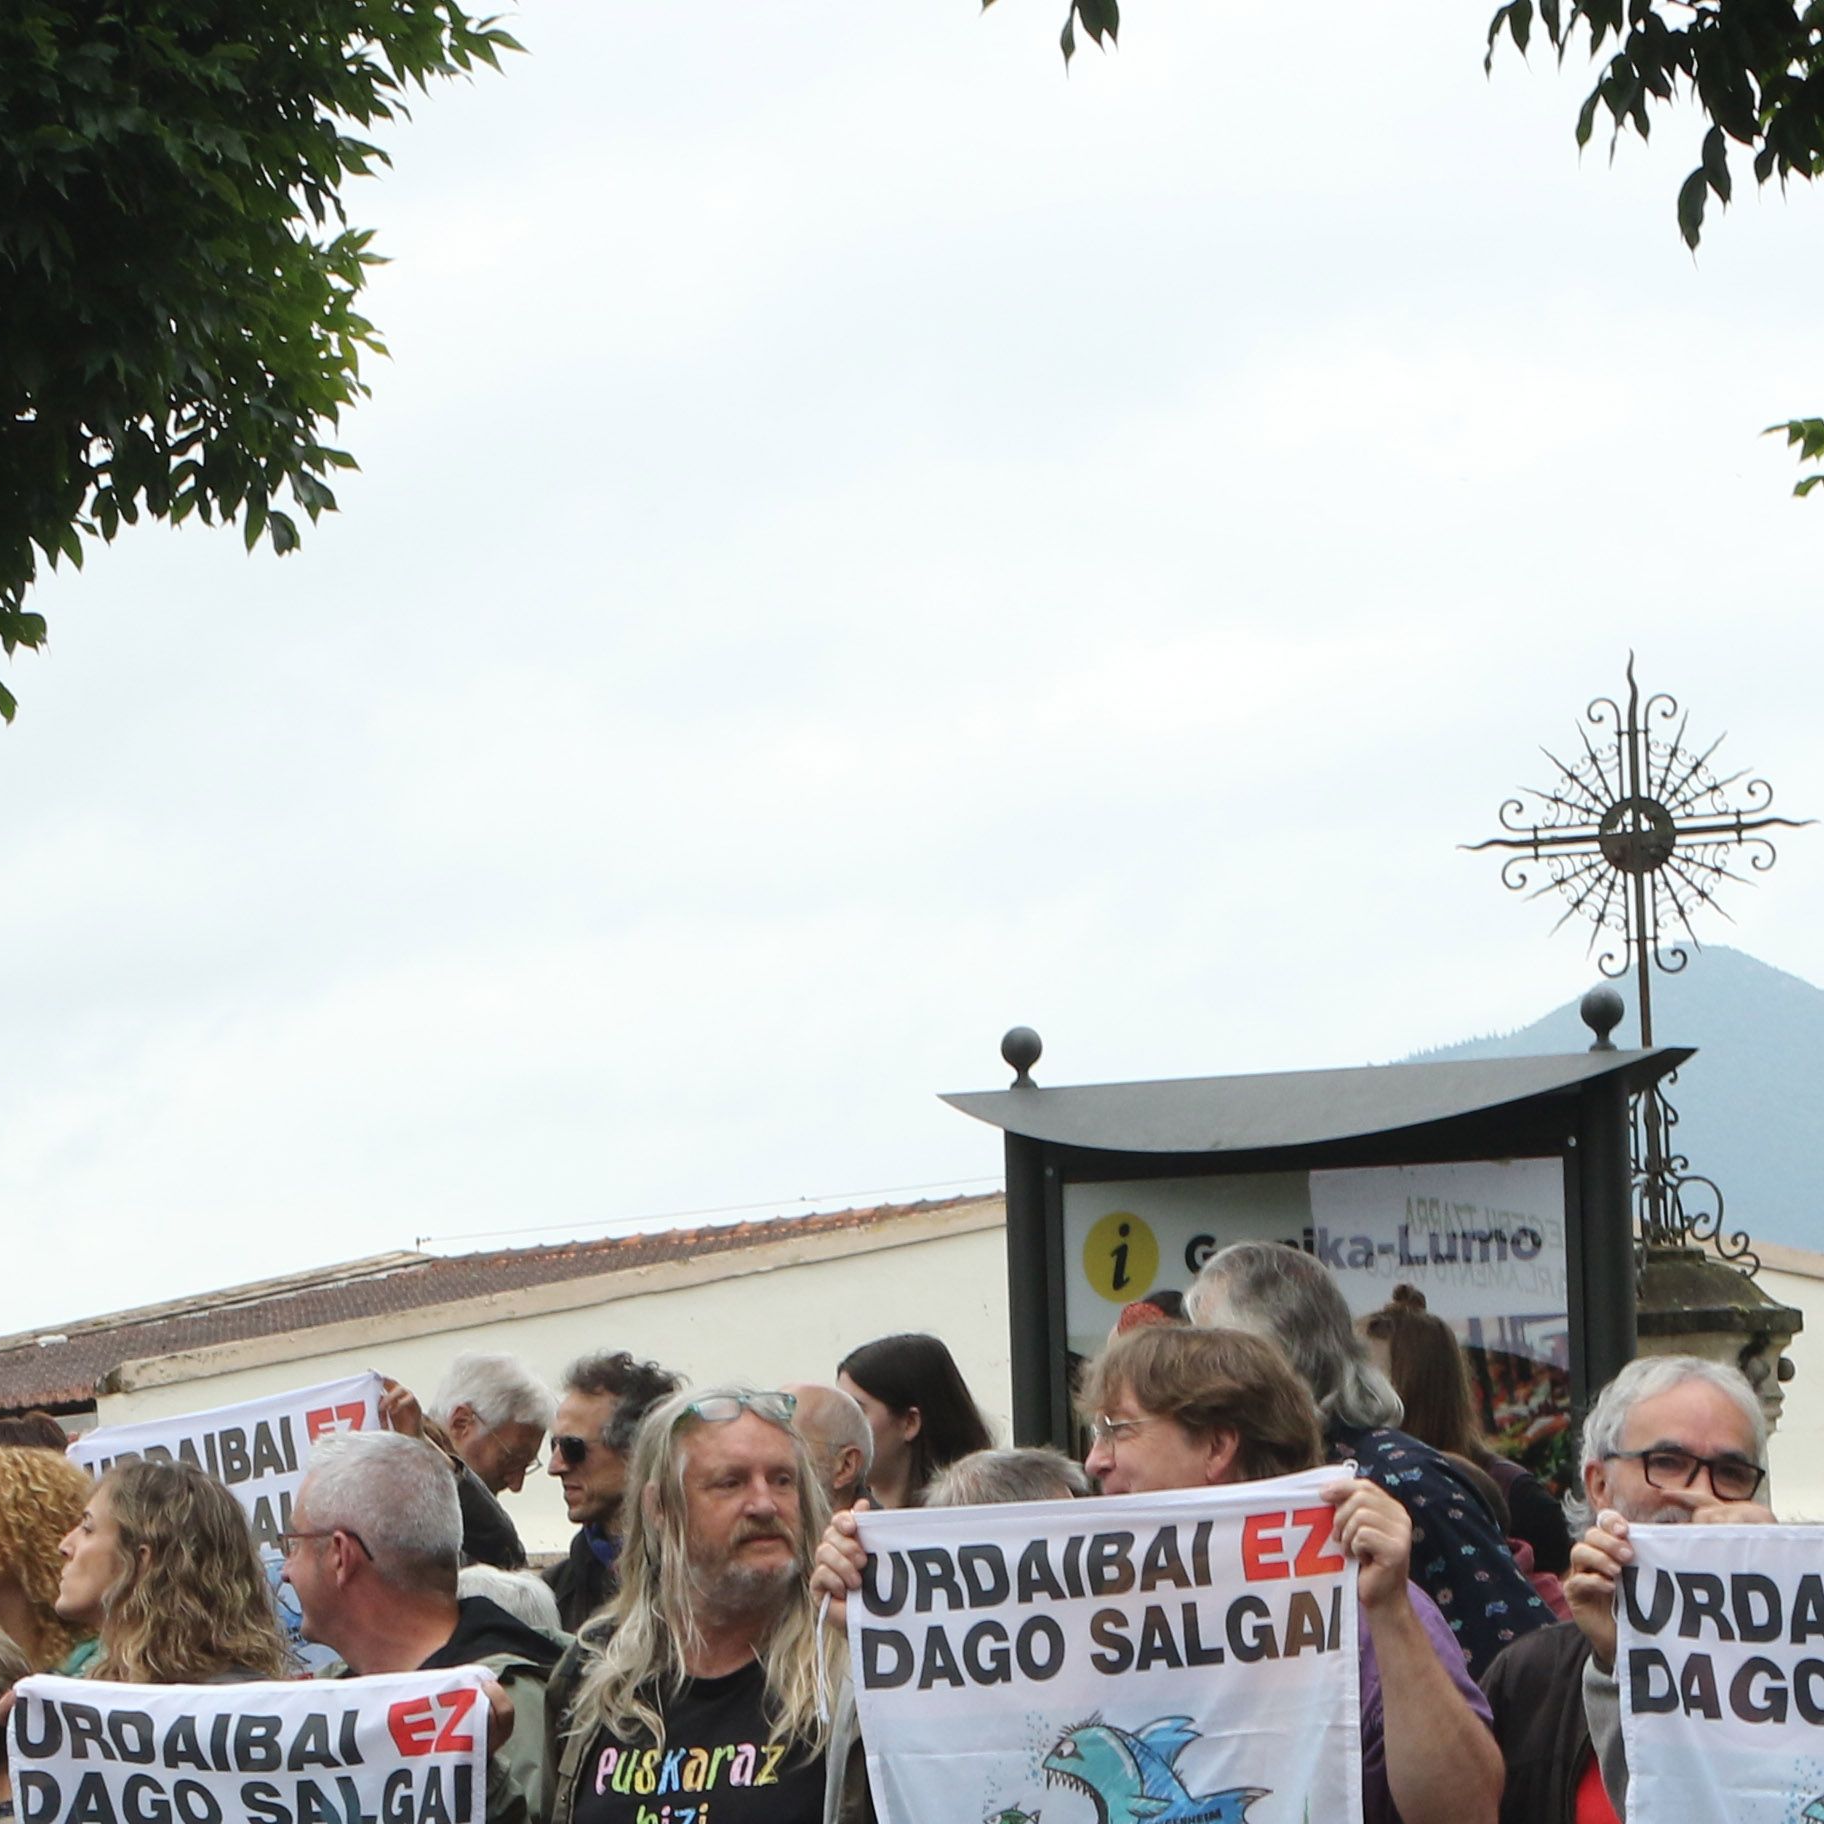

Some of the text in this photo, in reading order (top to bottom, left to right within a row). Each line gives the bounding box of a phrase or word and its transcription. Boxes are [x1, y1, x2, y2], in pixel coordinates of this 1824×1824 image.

[1184, 1225, 1542, 1276] Gika-Lumo
[860, 1506, 1345, 1618] URDAIBAI EZ
[862, 1586, 1343, 1690] DAGO SALGAI
[14, 1688, 479, 1773] URDAIBAI EZ
[594, 1742, 785, 1797] euskaraz
